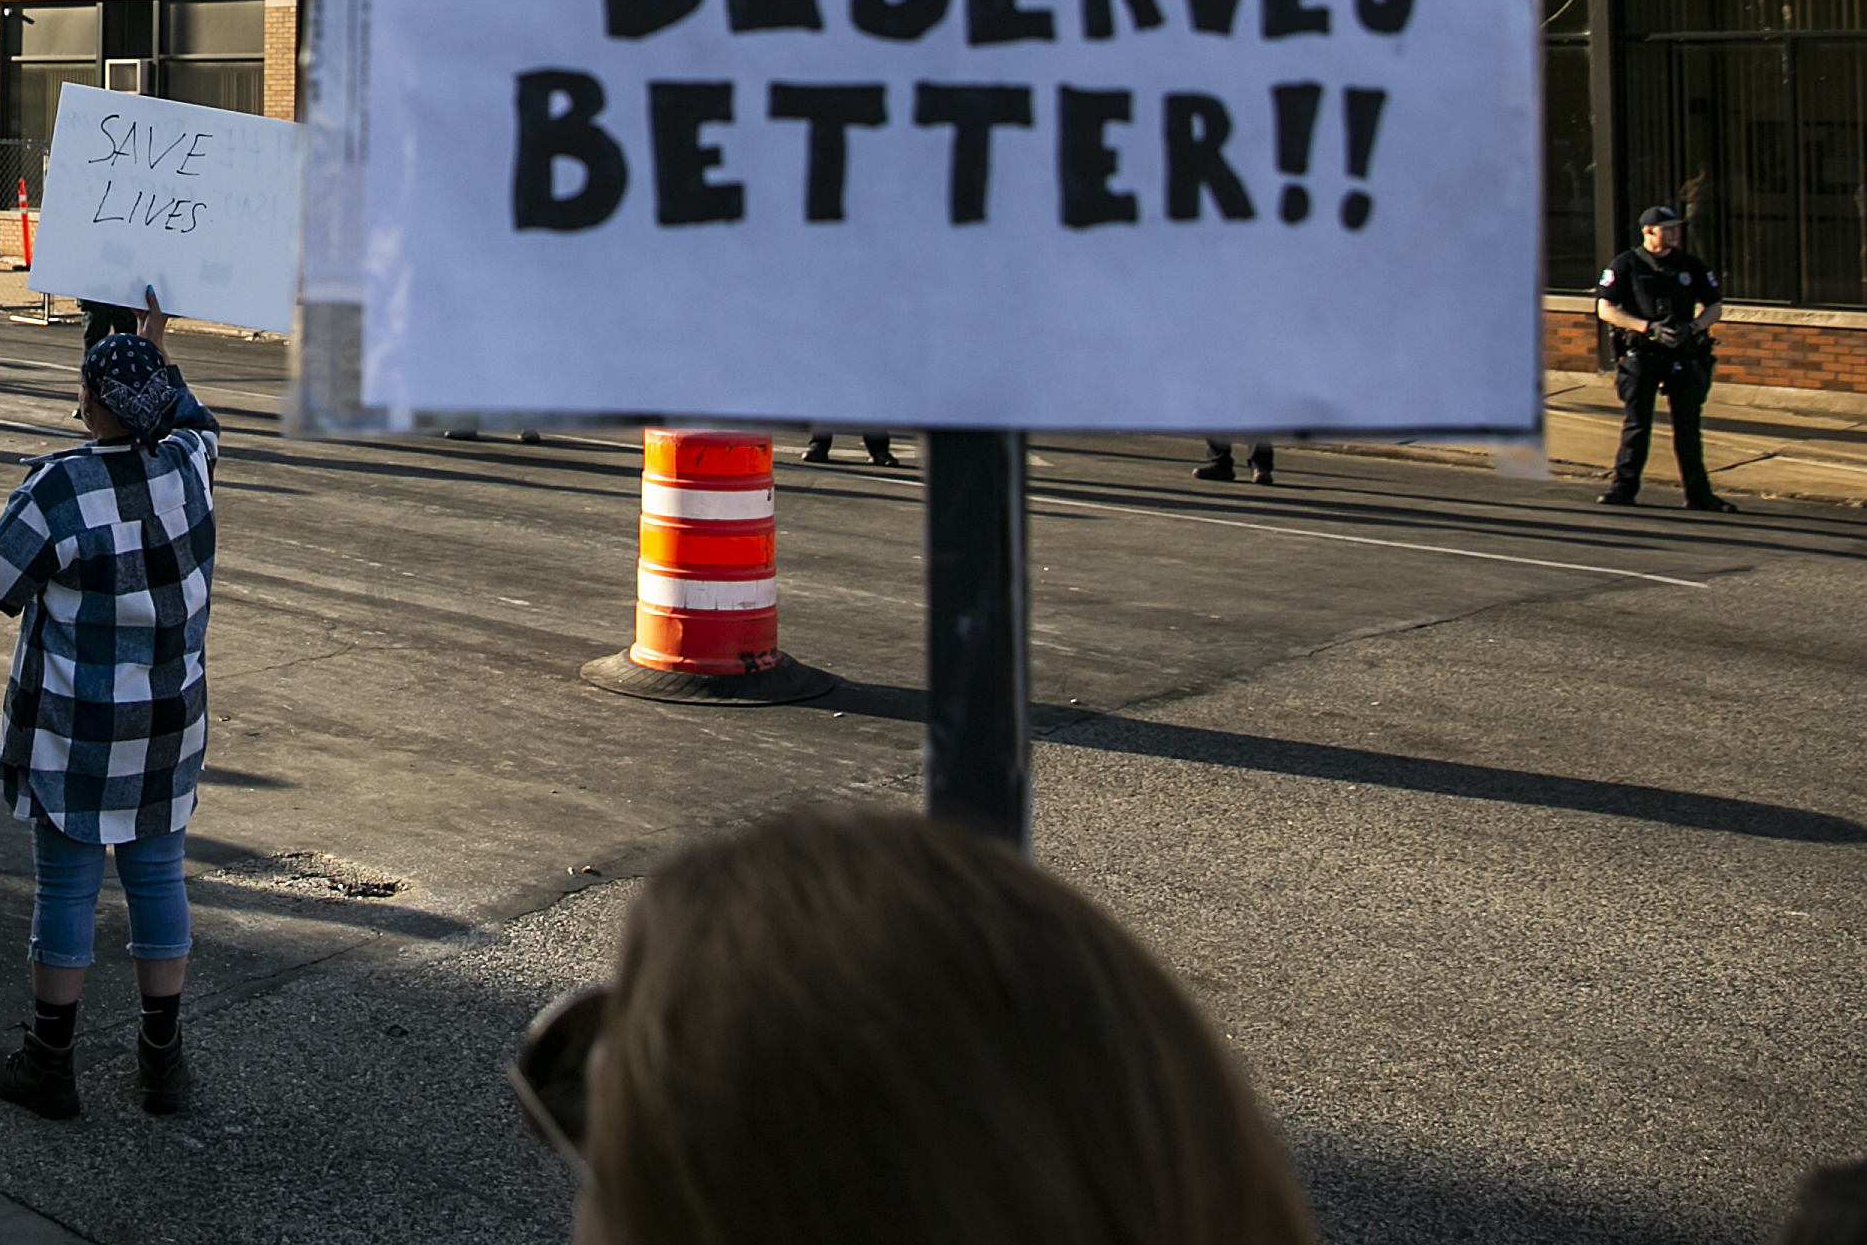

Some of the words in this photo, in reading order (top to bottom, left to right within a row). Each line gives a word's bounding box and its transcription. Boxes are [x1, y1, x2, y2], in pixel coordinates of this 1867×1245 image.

[88, 114, 213, 176] SAVE
[512, 68, 1388, 234] BETTER!!
[93, 181, 207, 233] LIVES
